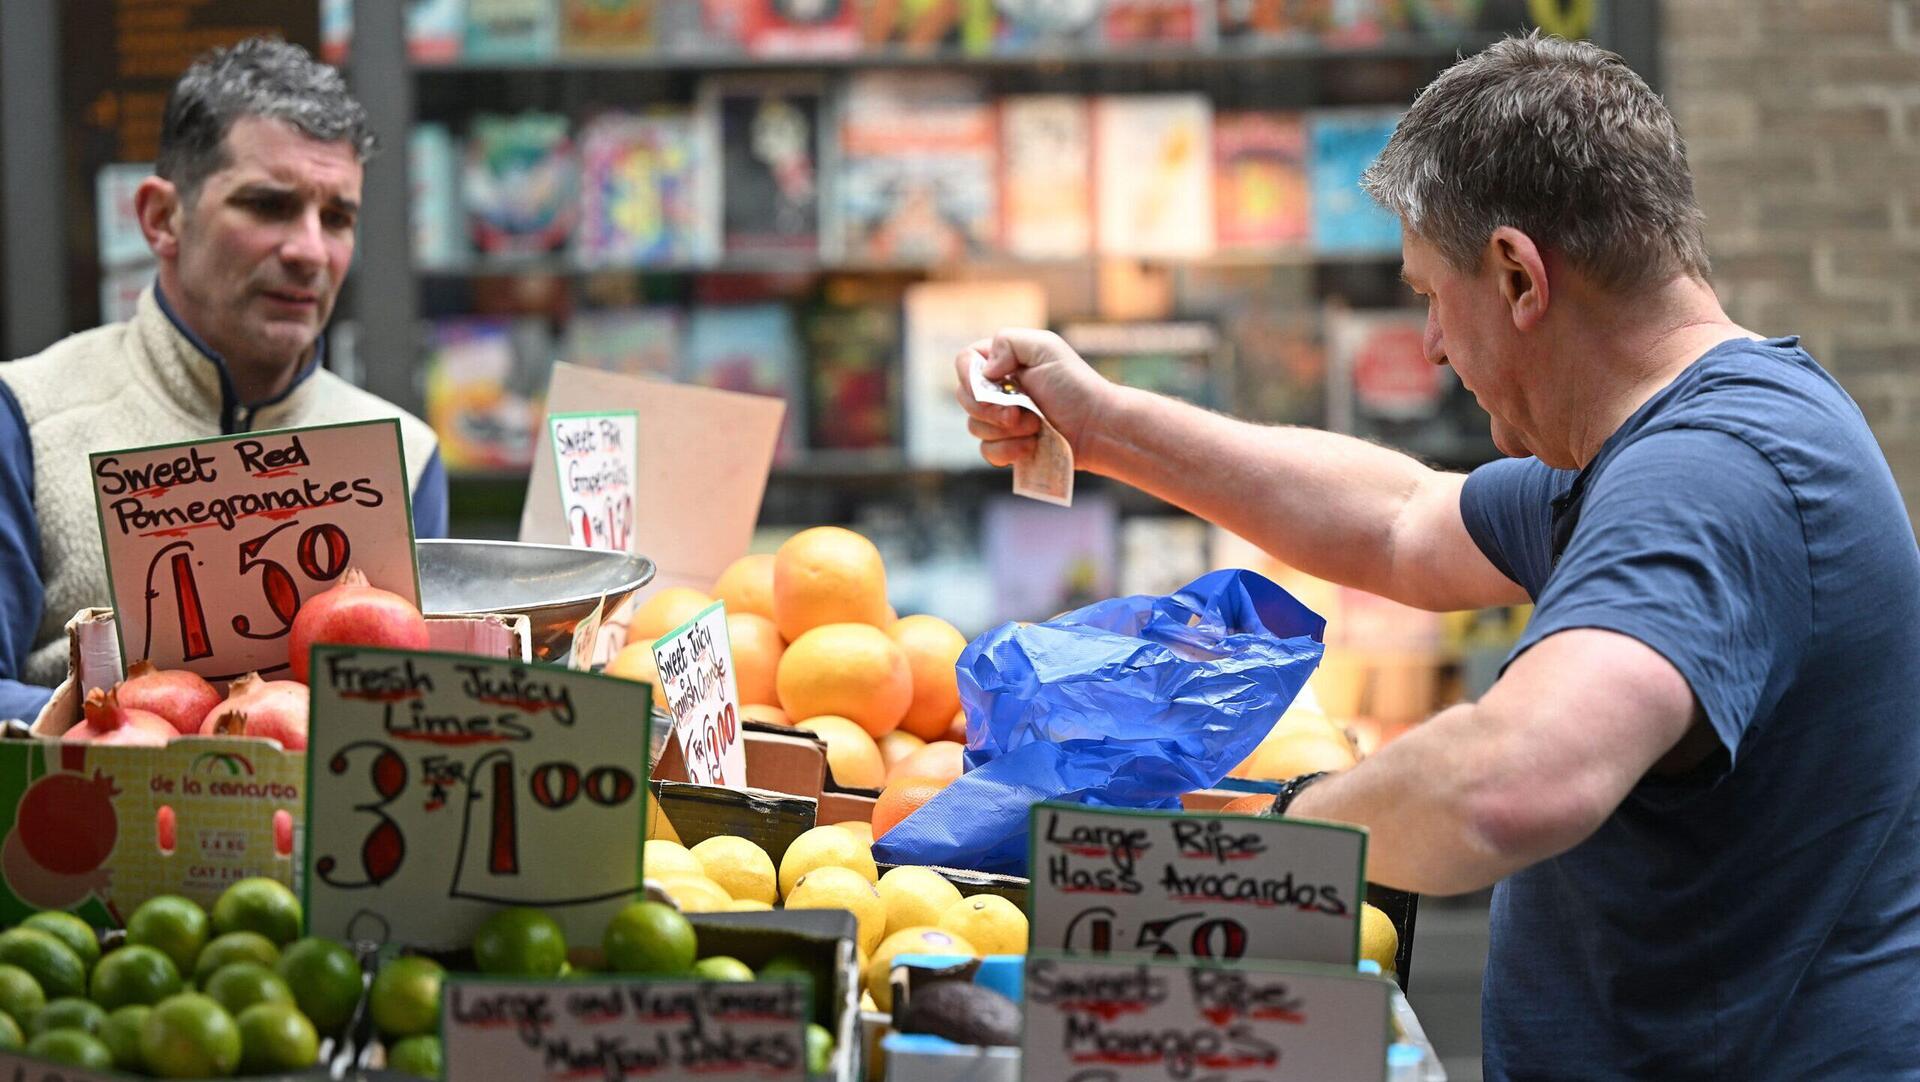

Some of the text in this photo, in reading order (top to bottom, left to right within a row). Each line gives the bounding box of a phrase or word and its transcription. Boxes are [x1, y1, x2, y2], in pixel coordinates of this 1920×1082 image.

[96, 436, 310, 495] Sweet Red
[111, 478, 384, 534] Pomegranates
[658, 622, 717, 684] Sweet Juicy
[327, 653, 575, 726] Fresh Juicy
[385, 702, 532, 741] Limes
[150, 775, 297, 799] de la canasta
[316, 740, 409, 889] 3
[1046, 815, 1266, 871] Large Ripe
[1050, 855, 1143, 895] Hass
[452, 985, 555, 1047] Large
[1064, 1013, 1280, 1079] Mangos
